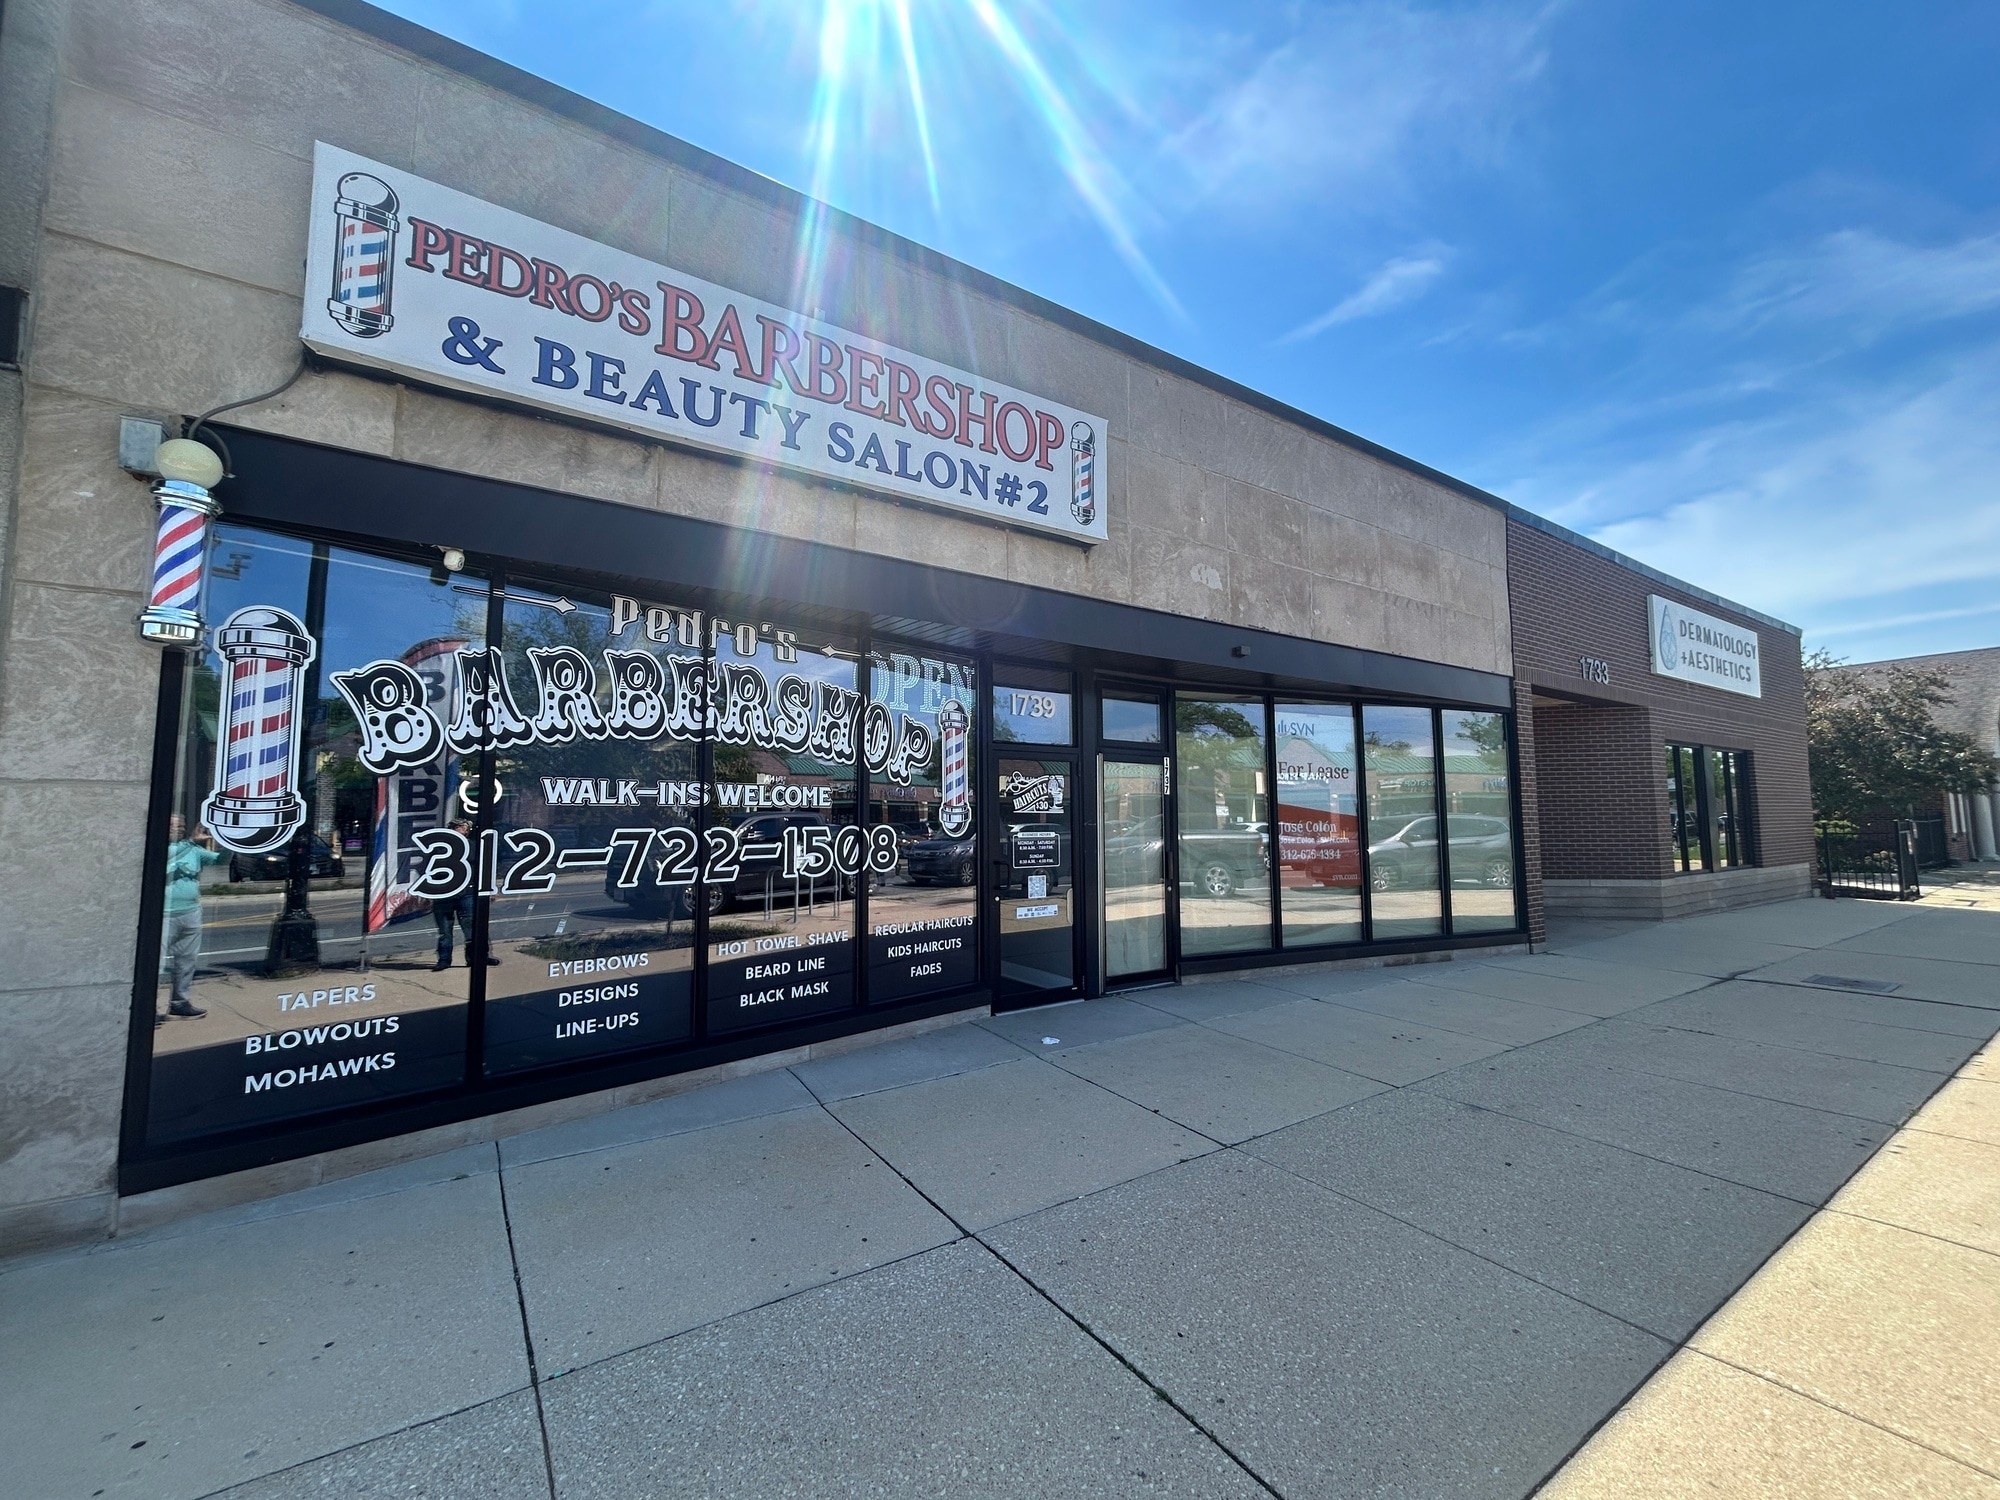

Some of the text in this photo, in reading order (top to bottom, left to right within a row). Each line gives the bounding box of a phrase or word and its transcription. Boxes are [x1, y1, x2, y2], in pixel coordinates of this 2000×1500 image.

[405, 216, 1064, 472] PEDRO'S BARBERSHOP
[441, 316, 1049, 515] & BEAUTY SALON #2
[610, 594, 799, 664] Pedro's
[1679, 619, 1756, 660] DERMATOLOGY
[1580, 656, 1609, 685] 1733
[1681, 650, 1751, 682] +AESTHETICS
[853, 650, 975, 716] OPEN
[330, 645, 932, 785] BARBERSHOP
[1010, 693, 1056, 719] 1739
[1290, 722, 1315, 736] SVN
[1278, 761, 1304, 778] For
[1307, 762, 1349, 779] Lease
[539, 777, 833, 809] WALK-INS WELCOME
[1013, 782, 1047, 810] HAIRCUTS
[1035, 800, 1049, 810] $30
[1305, 820, 1337, 833] Colón
[409, 825, 898, 898] 312-722-1508
[875, 915, 974, 937] REGULAR HAIRCUTS
[717, 930, 849, 957] HOT TOWEL SHAVE
[887, 938, 963, 959] KIDS HAIRCUTS
[548, 952, 650, 978] EYEBROWS
[744, 957, 826, 981] BEARD LINE
[910, 962, 943, 978] FADES
[277, 983, 378, 1012] TAPERS
[558, 983, 640, 1007] DESIGNS
[738, 981, 829, 1008] BLACK MASK
[245, 1016, 401, 1055] BLOWOUTS
[555, 1011, 640, 1039] LINE-UPS
[244, 1052, 397, 1094] MOHAWKS
